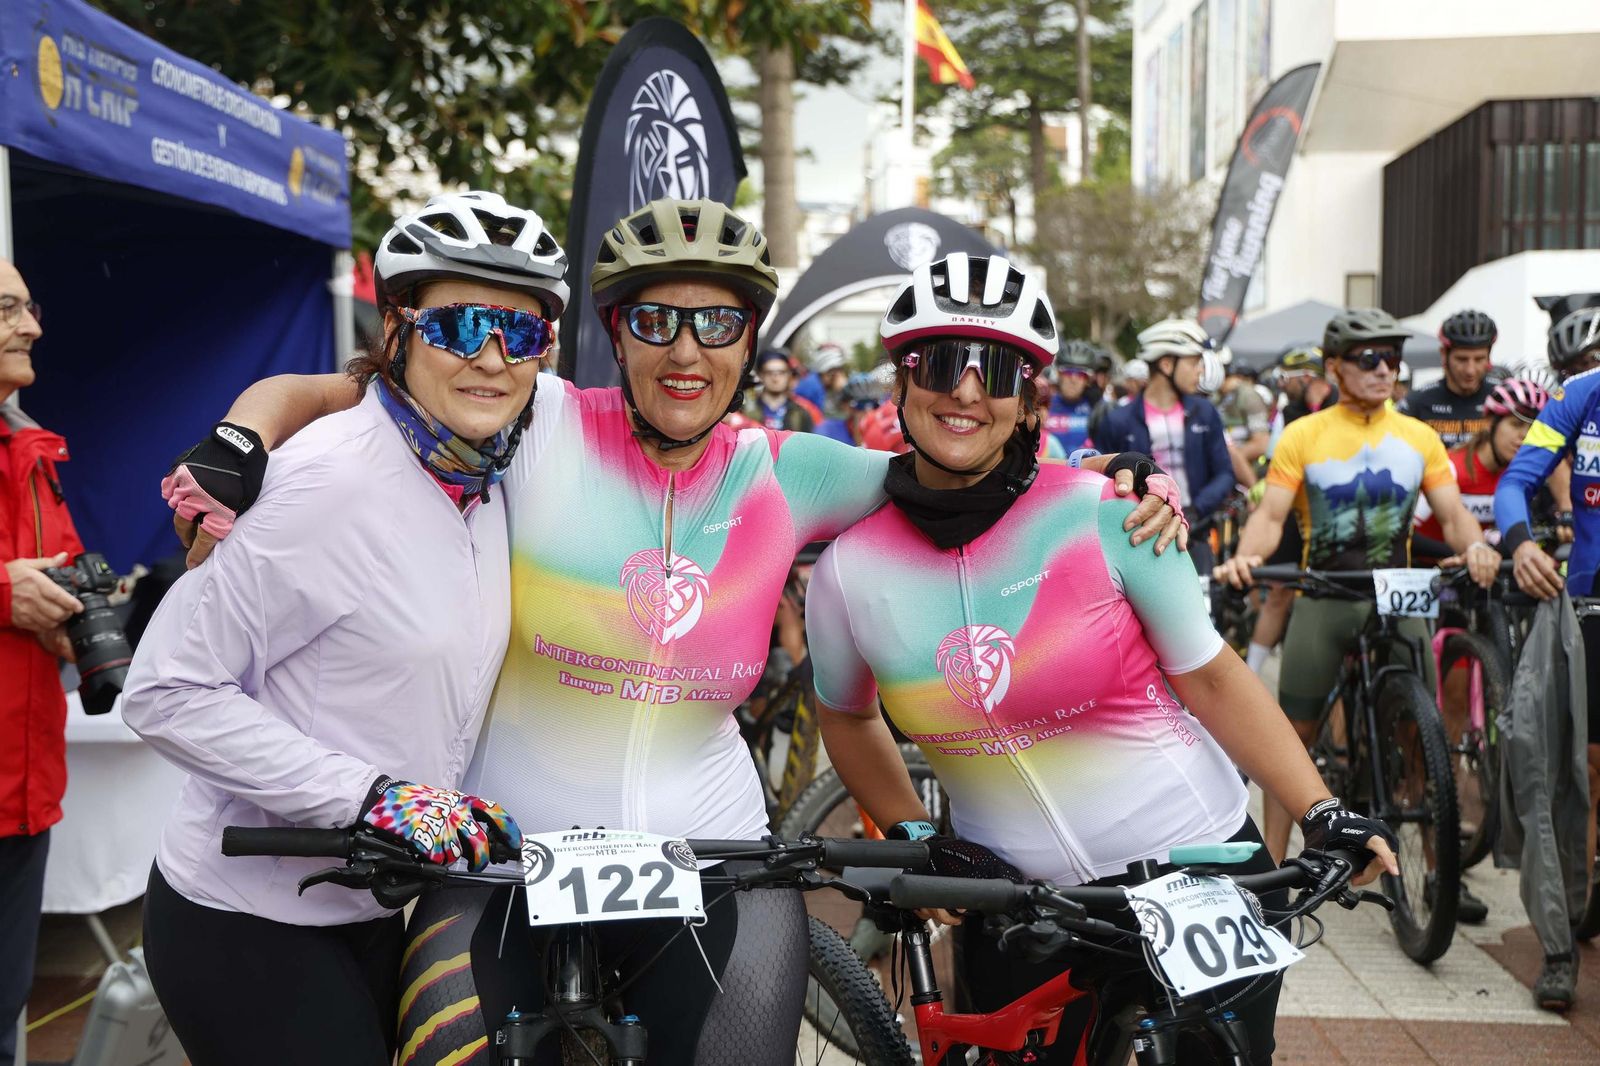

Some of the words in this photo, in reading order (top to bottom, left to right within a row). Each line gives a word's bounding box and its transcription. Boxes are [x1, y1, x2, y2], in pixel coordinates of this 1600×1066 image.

[951, 316, 996, 326] OAKLEY
[703, 515, 743, 534] GSPORT
[1000, 569, 1051, 597] GSPORT
[1390, 590, 1430, 613] 023
[535, 634, 723, 681] INTERCONTINENTAL
[559, 671, 614, 695] Europa
[620, 679, 683, 705] MTB
[684, 688, 733, 701] Africa
[1055, 698, 1098, 721] RACE
[937, 746, 979, 757] Europa
[980, 733, 1034, 756] MTB
[1036, 724, 1072, 742] Africa
[553, 843, 633, 853] INTERCONTINENTAL
[558, 861, 680, 915] 122
[1183, 914, 1278, 978] 029
